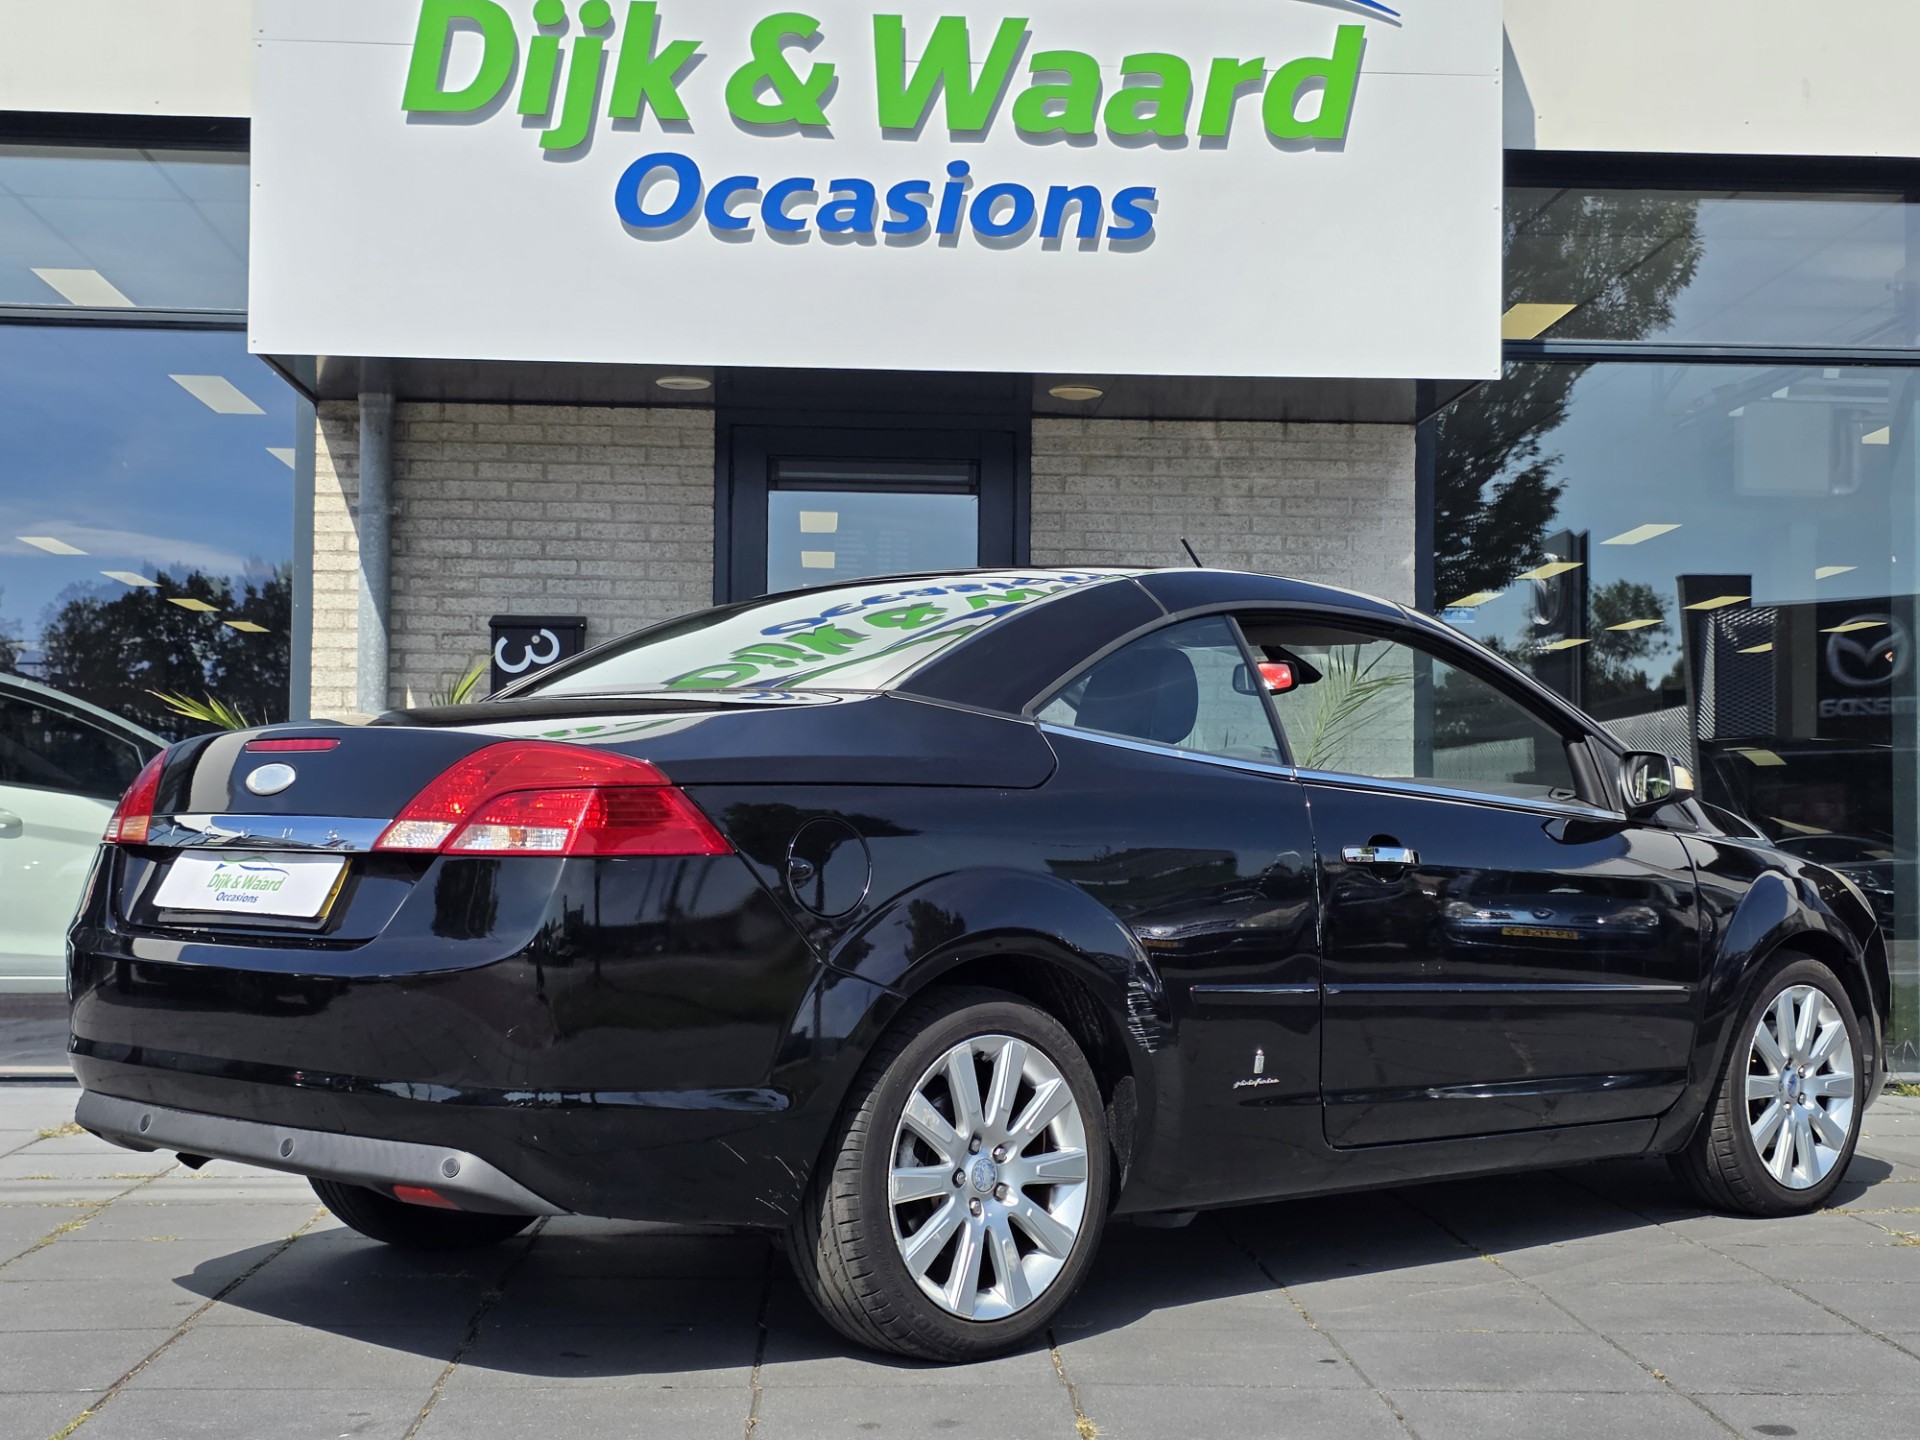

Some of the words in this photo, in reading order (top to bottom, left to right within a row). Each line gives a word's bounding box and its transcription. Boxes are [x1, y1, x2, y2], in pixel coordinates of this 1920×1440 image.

[403, 0, 701, 150] Dijk
[724, 12, 836, 126] &
[872, 14, 1366, 140] Waard
[614, 152, 1159, 241] Occasions
[207, 873, 233, 892] Dijk
[230, 875, 243, 889] &
[241, 875, 287, 892] Waard
[215, 891, 260, 904] Occasions
